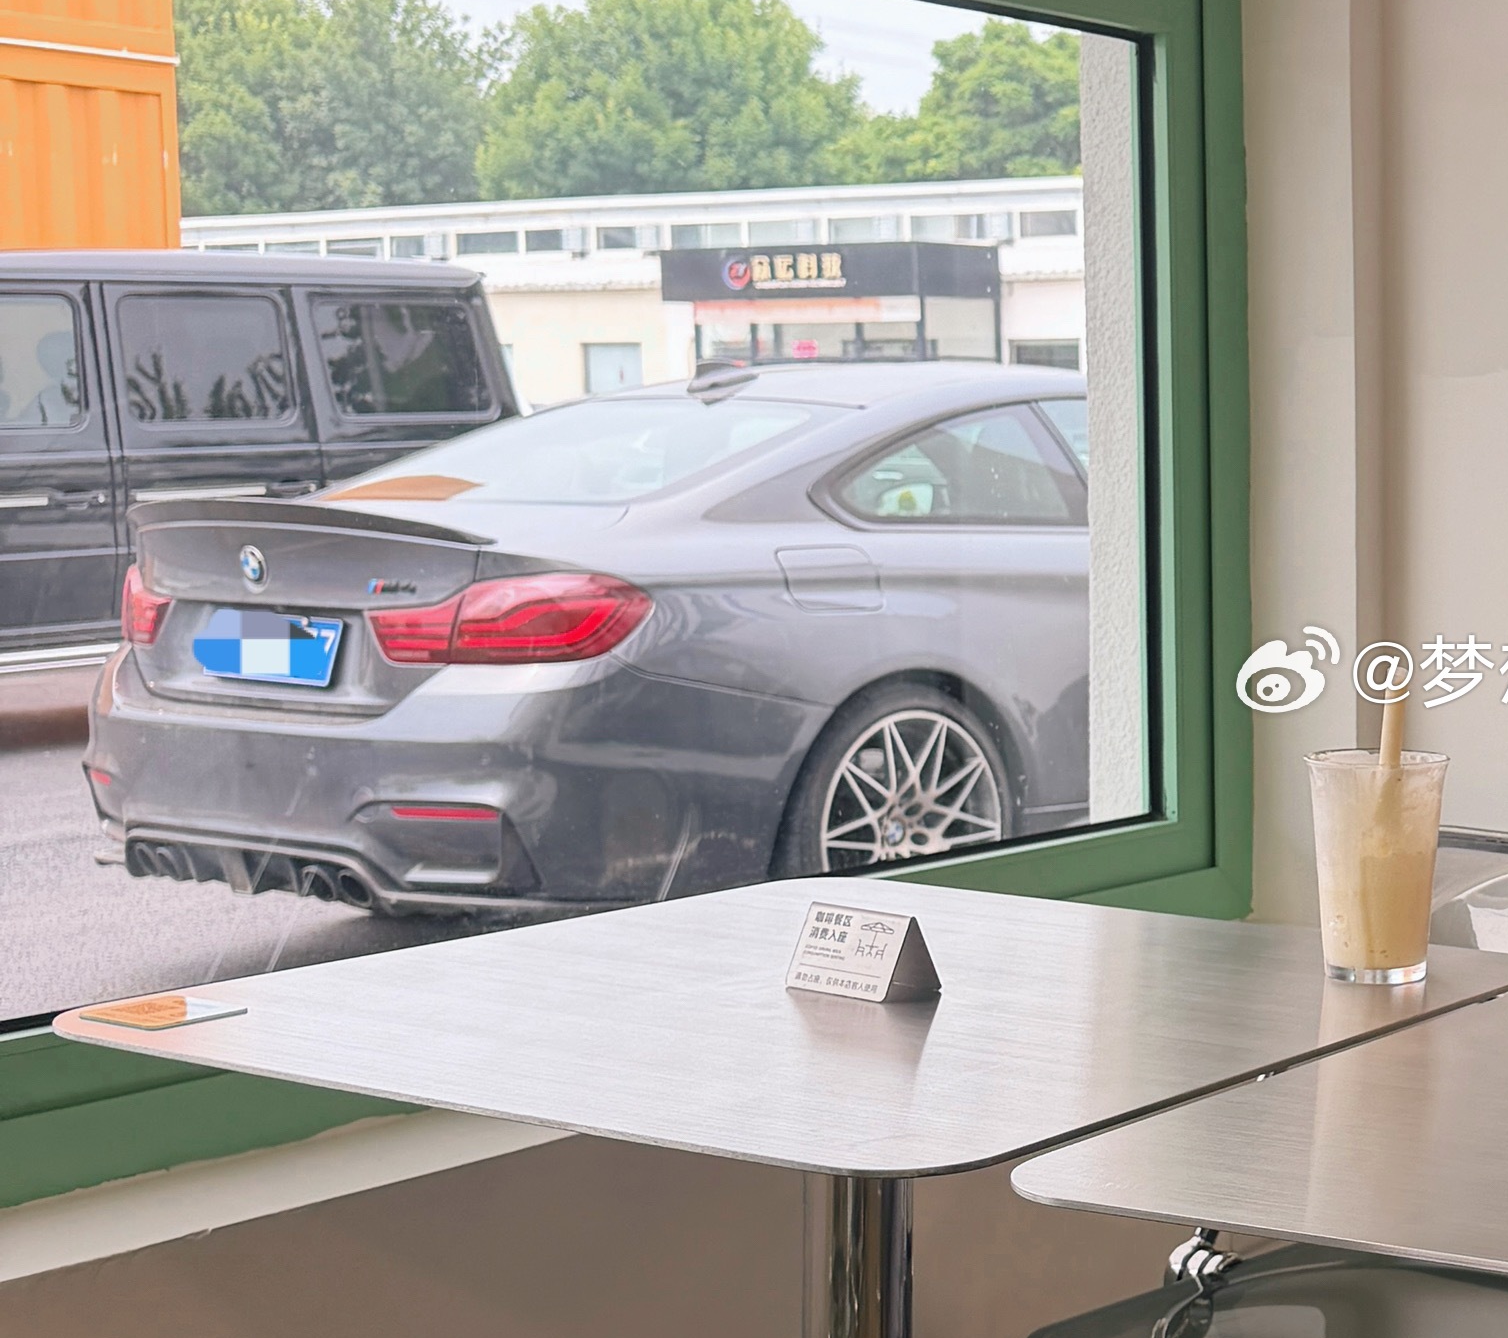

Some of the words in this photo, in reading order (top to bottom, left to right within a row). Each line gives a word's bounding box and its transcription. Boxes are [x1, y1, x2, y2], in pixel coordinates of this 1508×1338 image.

[814, 910, 853, 927] 咖啡餐区
[808, 926, 849, 943] 消费入座
